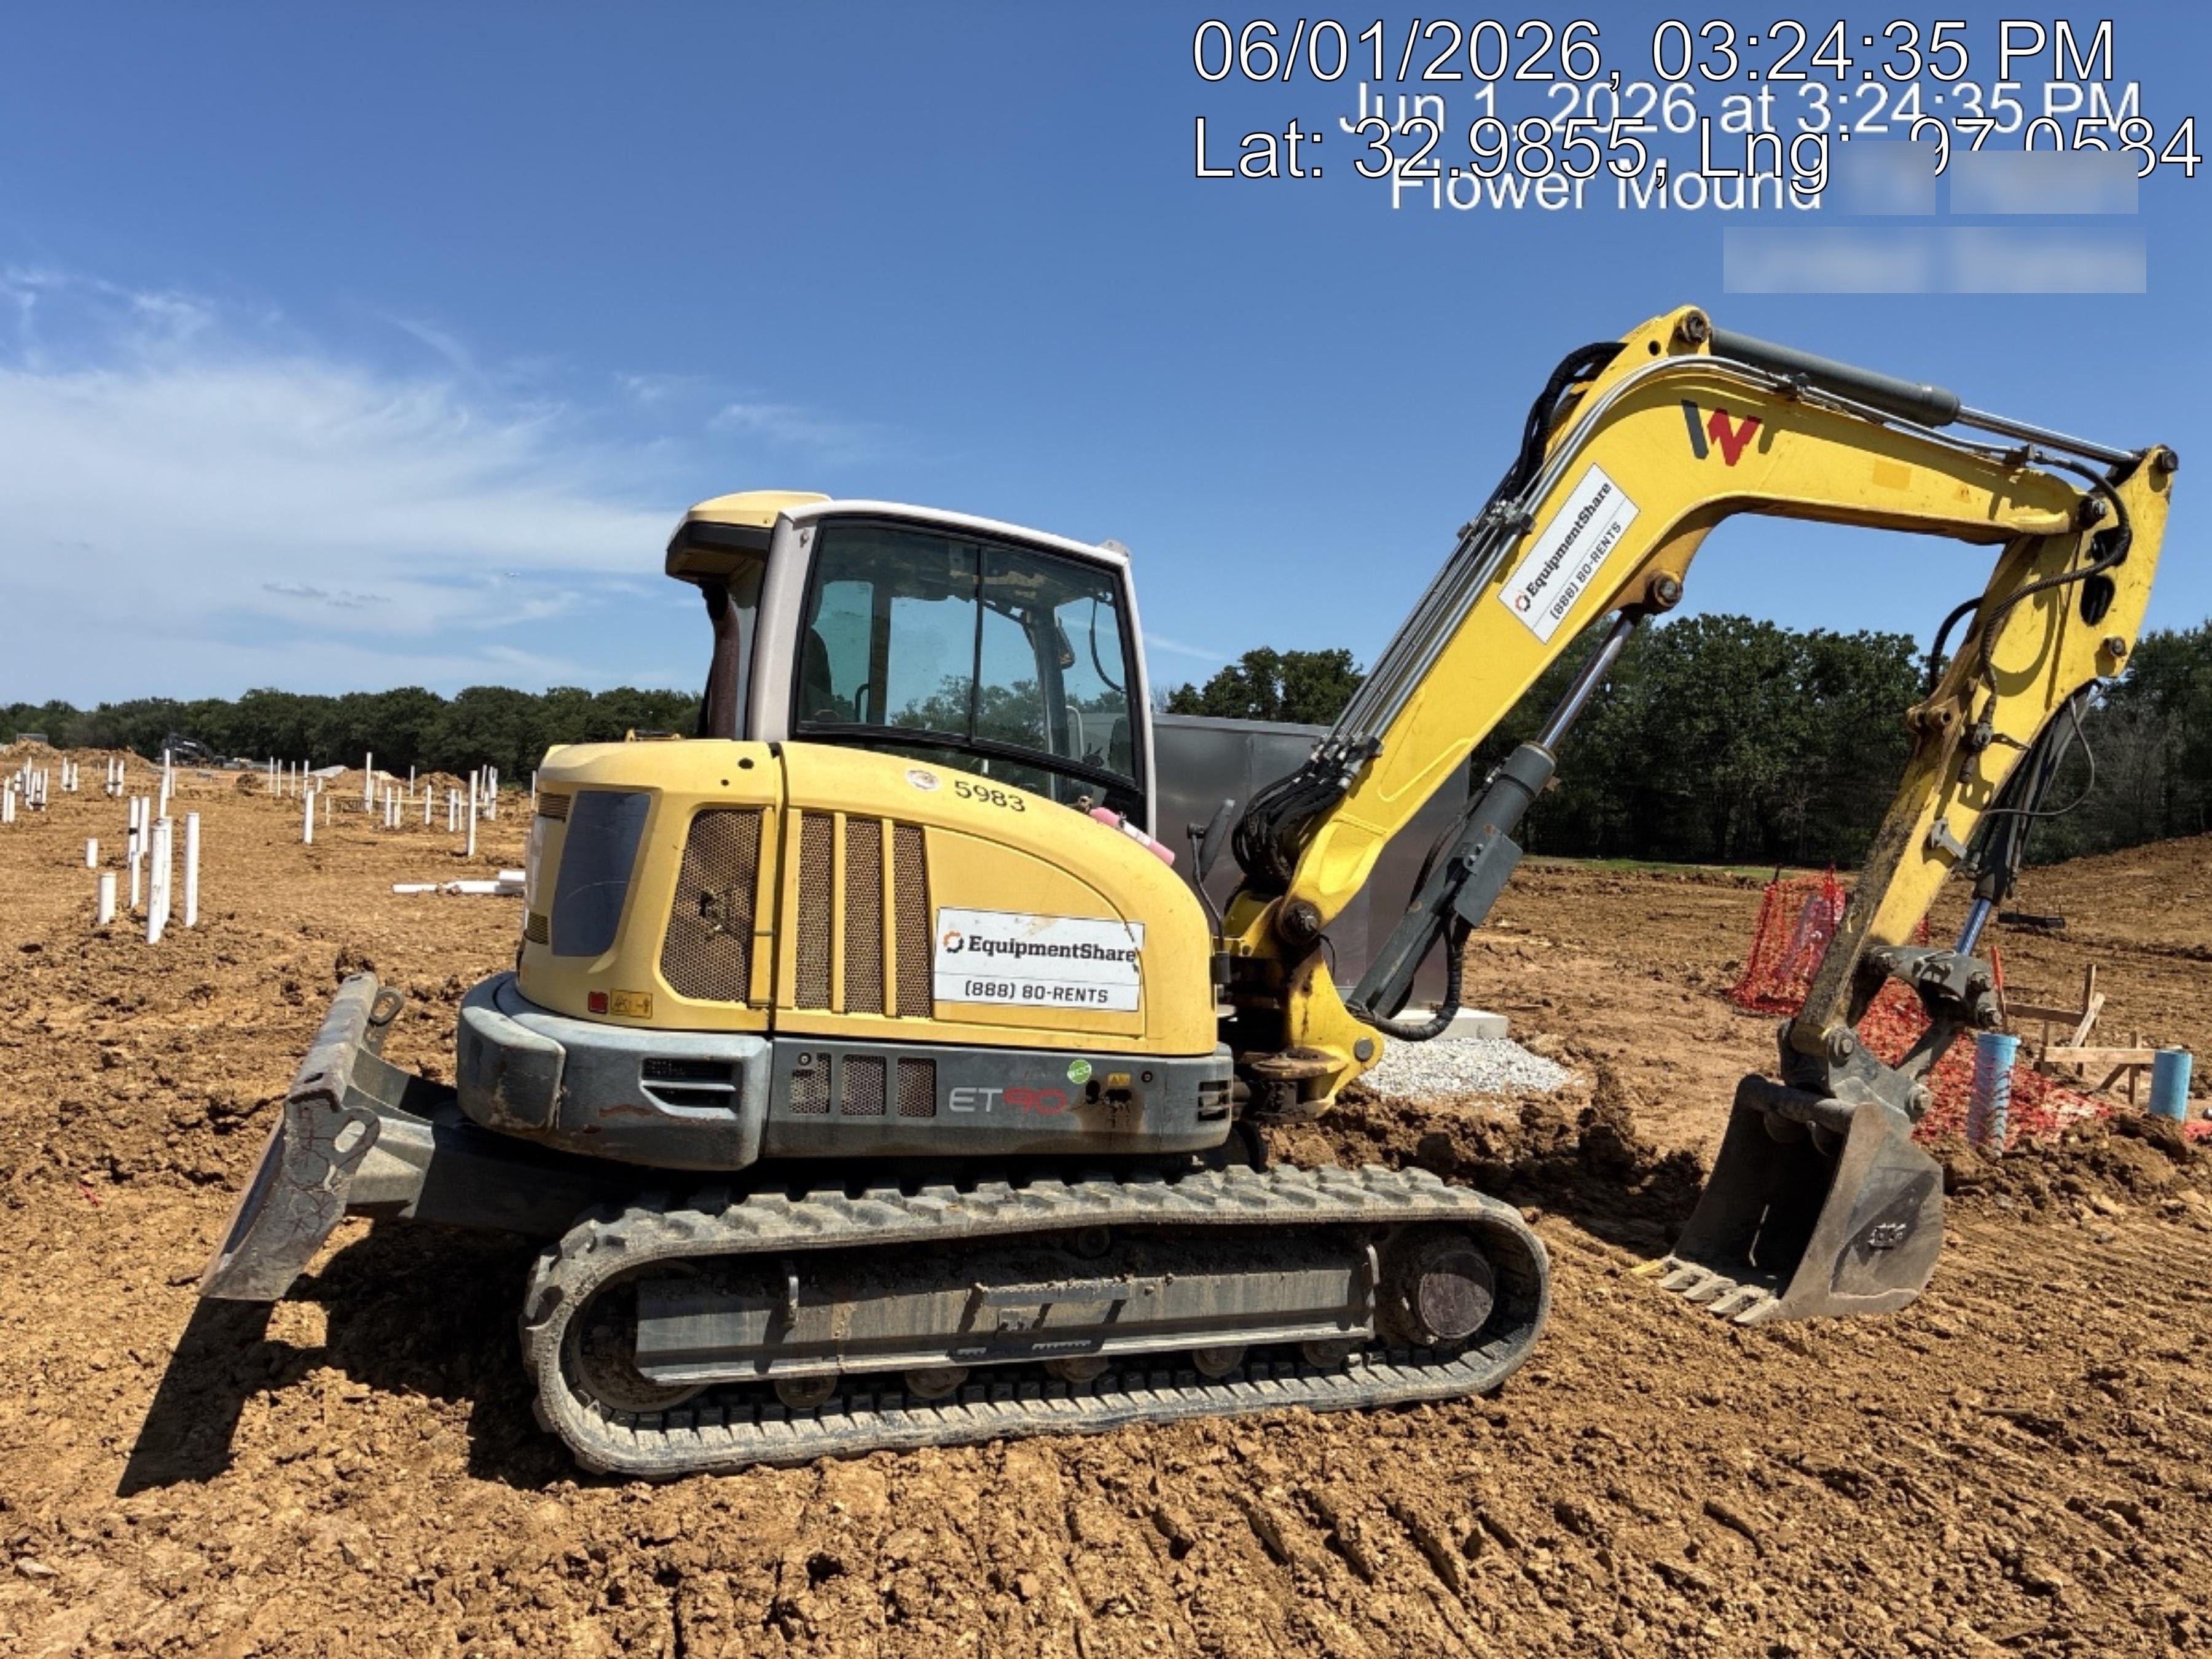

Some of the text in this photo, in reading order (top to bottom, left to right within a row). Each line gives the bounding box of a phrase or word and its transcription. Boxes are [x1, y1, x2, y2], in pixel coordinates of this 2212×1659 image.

[1526, 482, 1612, 598] EquipmentShare
[1549, 521, 1622, 621] (888) 80-RENTS
[954, 780, 1026, 813] 5983
[968, 935, 1137, 963] EquipmentShare
[965, 979, 1108, 1004] (888) 80-RENTS
[948, 1086, 1068, 1116] ET90
